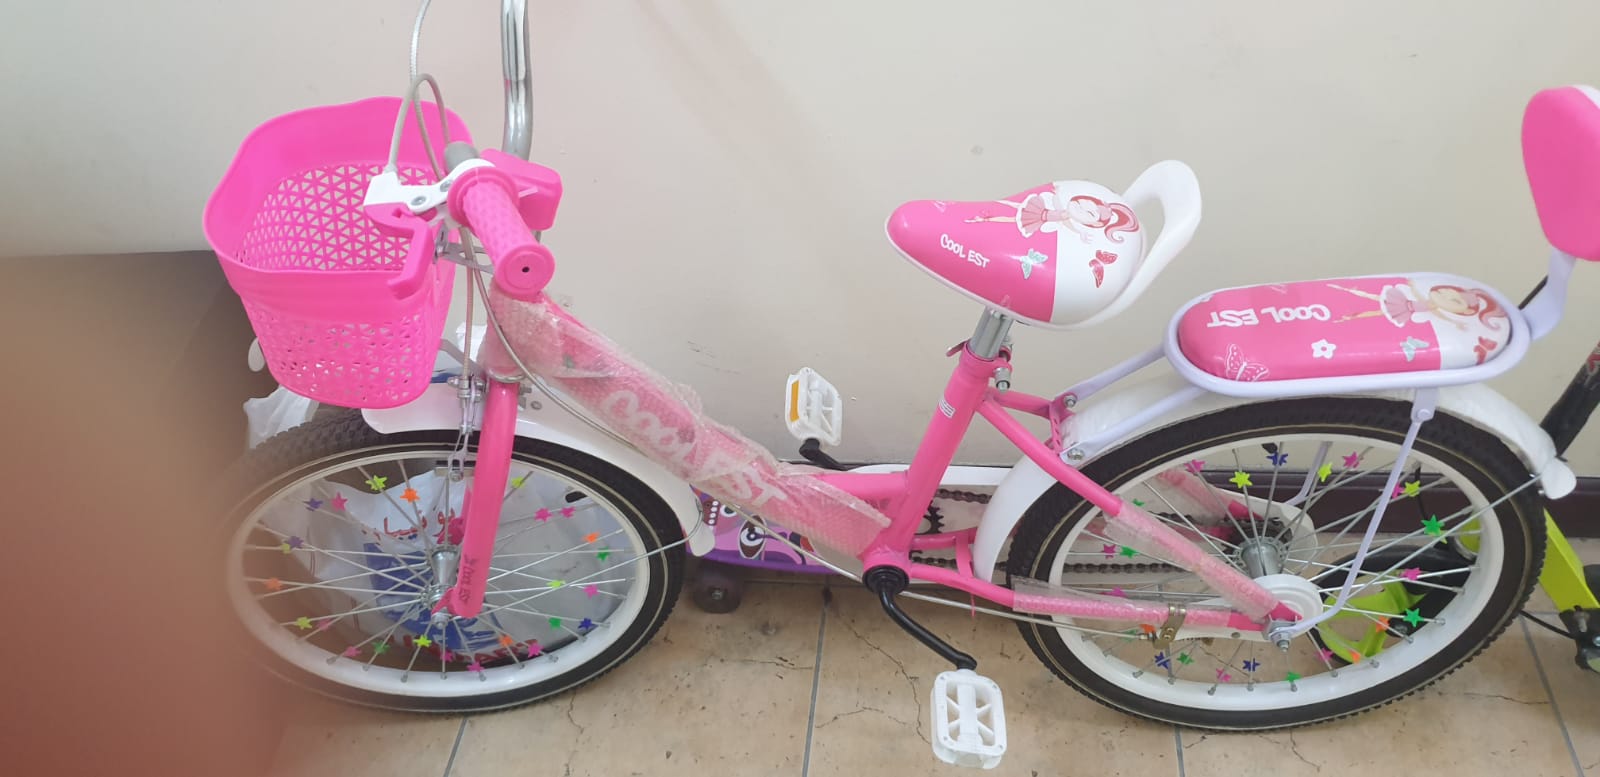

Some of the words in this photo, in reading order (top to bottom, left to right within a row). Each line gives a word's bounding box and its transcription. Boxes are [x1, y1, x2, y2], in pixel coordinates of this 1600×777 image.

[940, 233, 966, 259] COOL
[968, 249, 990, 268] EST
[1206, 308, 1260, 328] EST
[1261, 303, 1331, 323] COOL
[605, 390, 695, 472] COOL
[698, 448, 788, 506] EST
